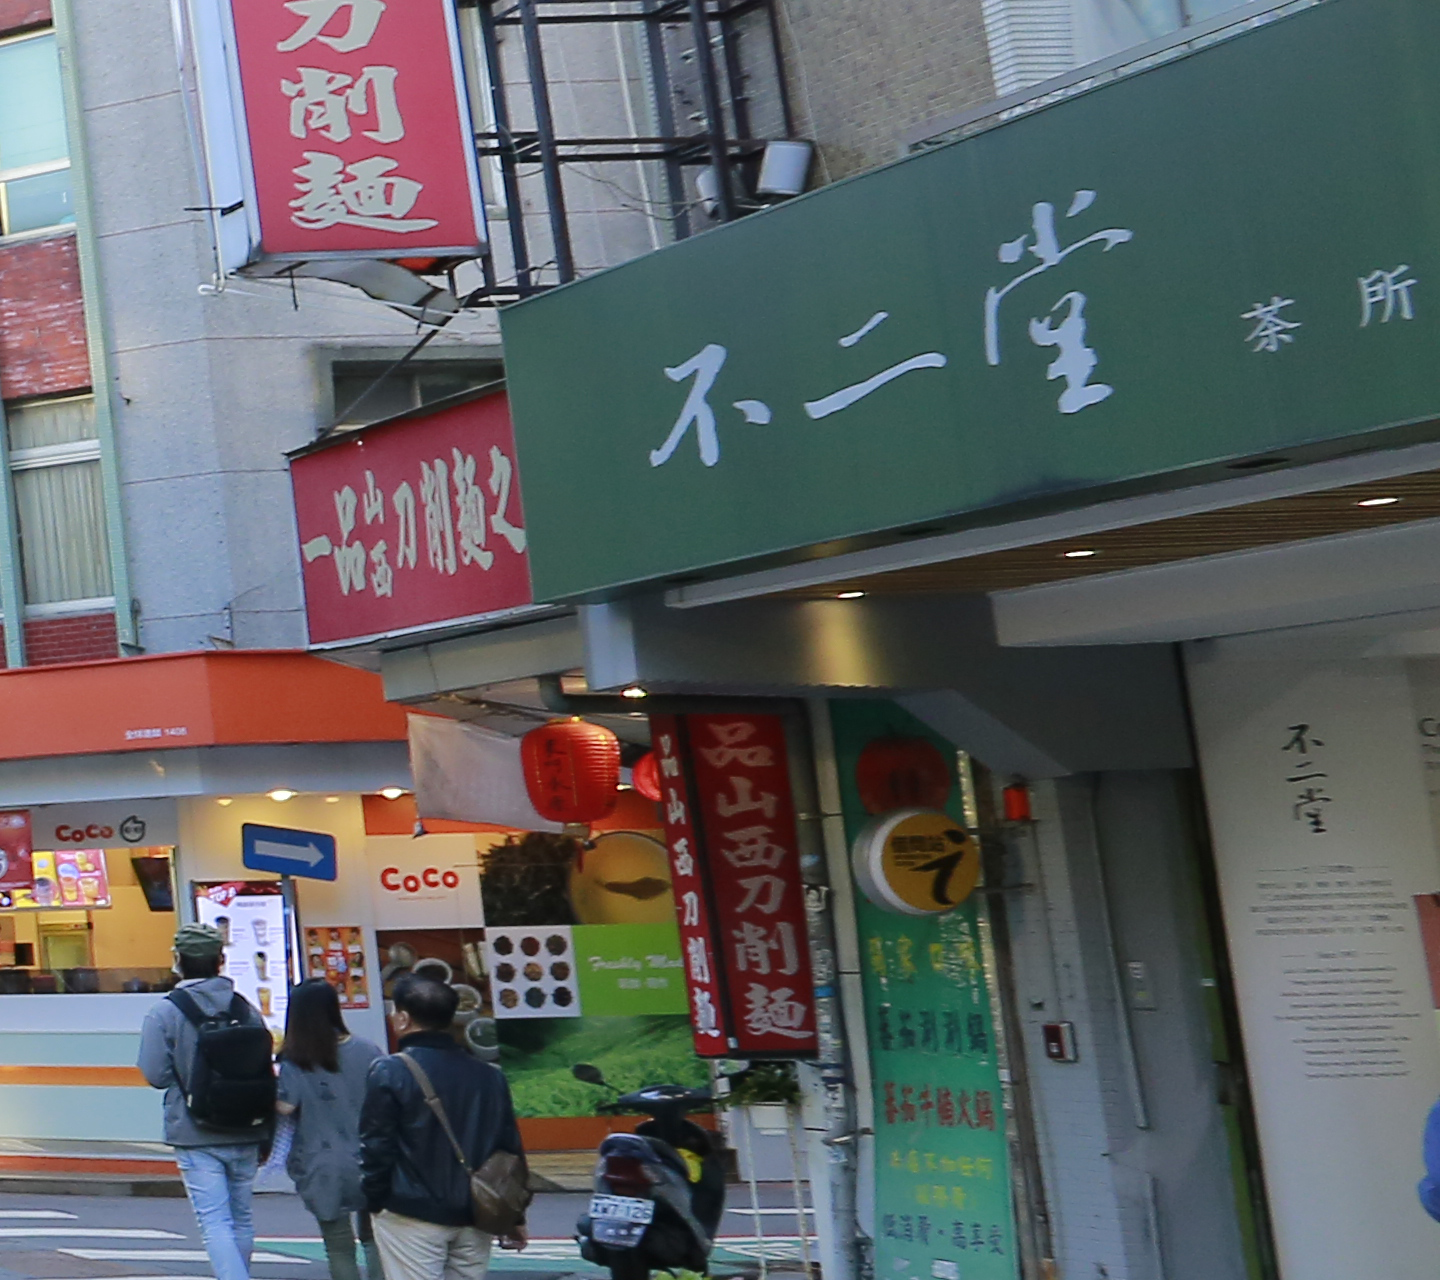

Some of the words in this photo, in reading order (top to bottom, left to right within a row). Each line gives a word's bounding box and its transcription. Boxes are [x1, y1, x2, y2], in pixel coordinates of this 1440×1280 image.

[650, 188, 1133, 468] 不二堂
[1241, 262, 1418, 354] 茶所
[1280, 723, 1333, 833] 不二堂
[55, 823, 113, 844] CoCo
[380, 866, 460, 893] CoCo
